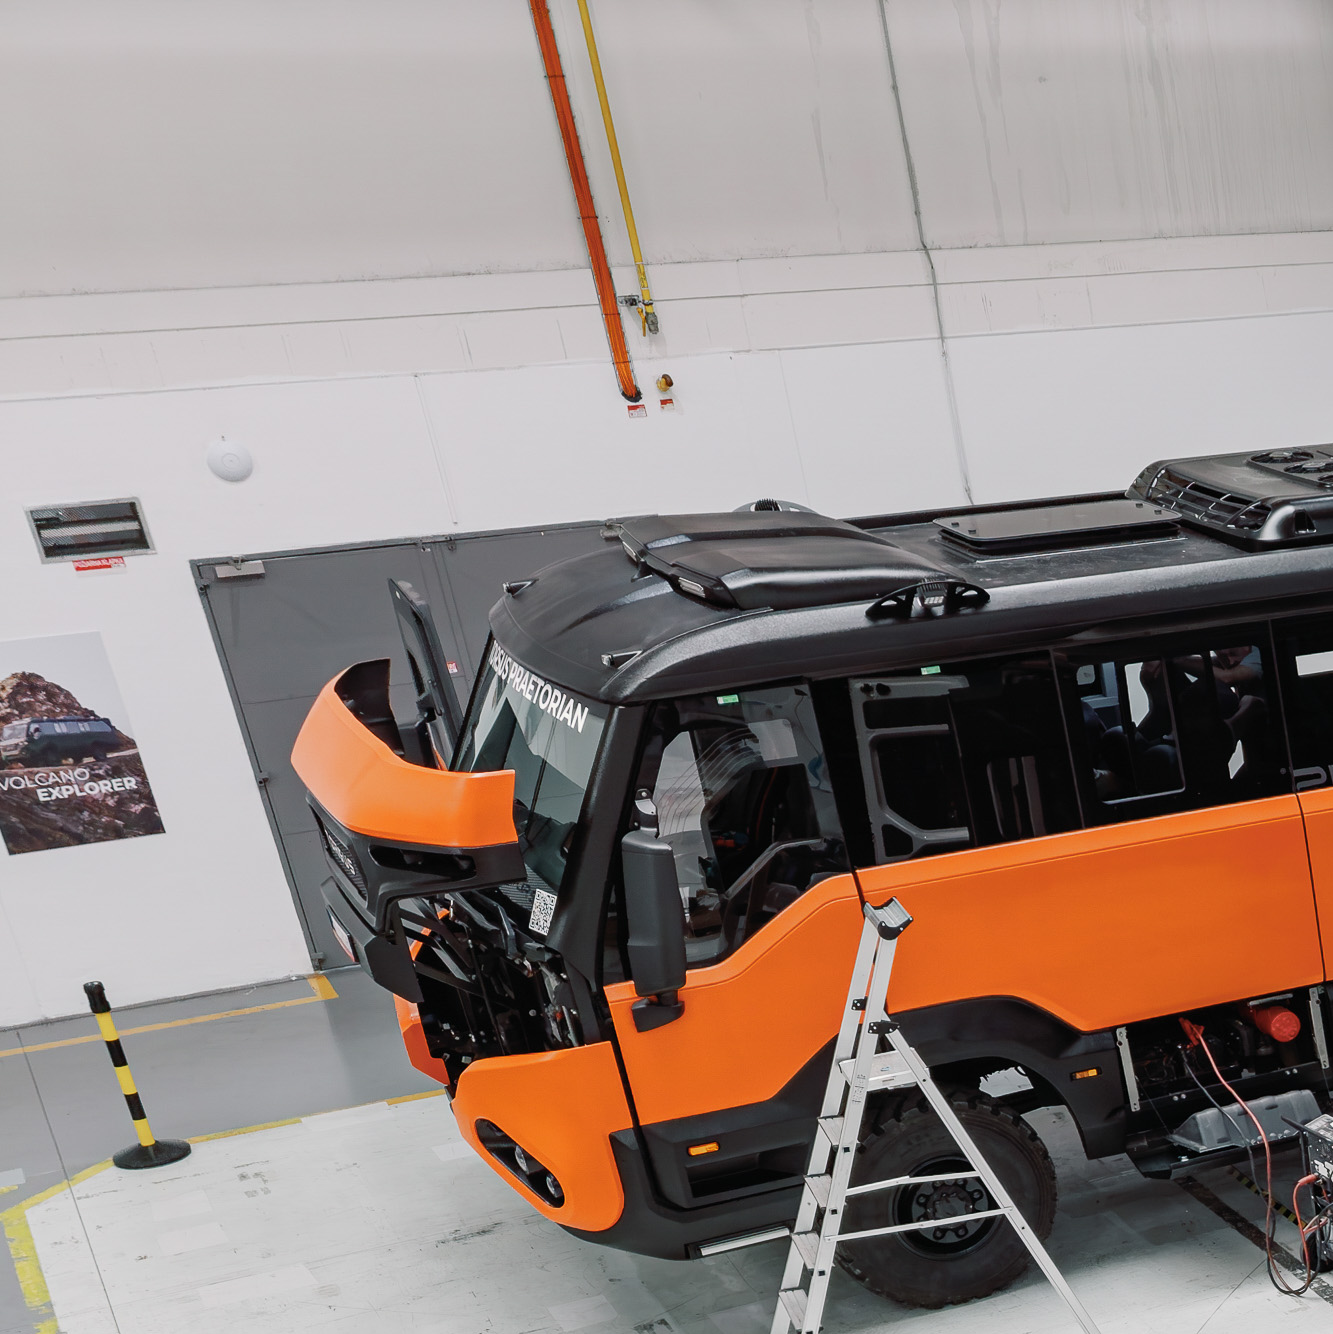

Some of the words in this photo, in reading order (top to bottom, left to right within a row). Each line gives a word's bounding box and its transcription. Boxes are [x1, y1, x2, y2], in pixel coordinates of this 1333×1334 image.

[507, 661, 589, 734] PRAETORIAN
[0, 767, 90, 792] VOLCANO
[36, 776, 138, 801] EXPLORER
